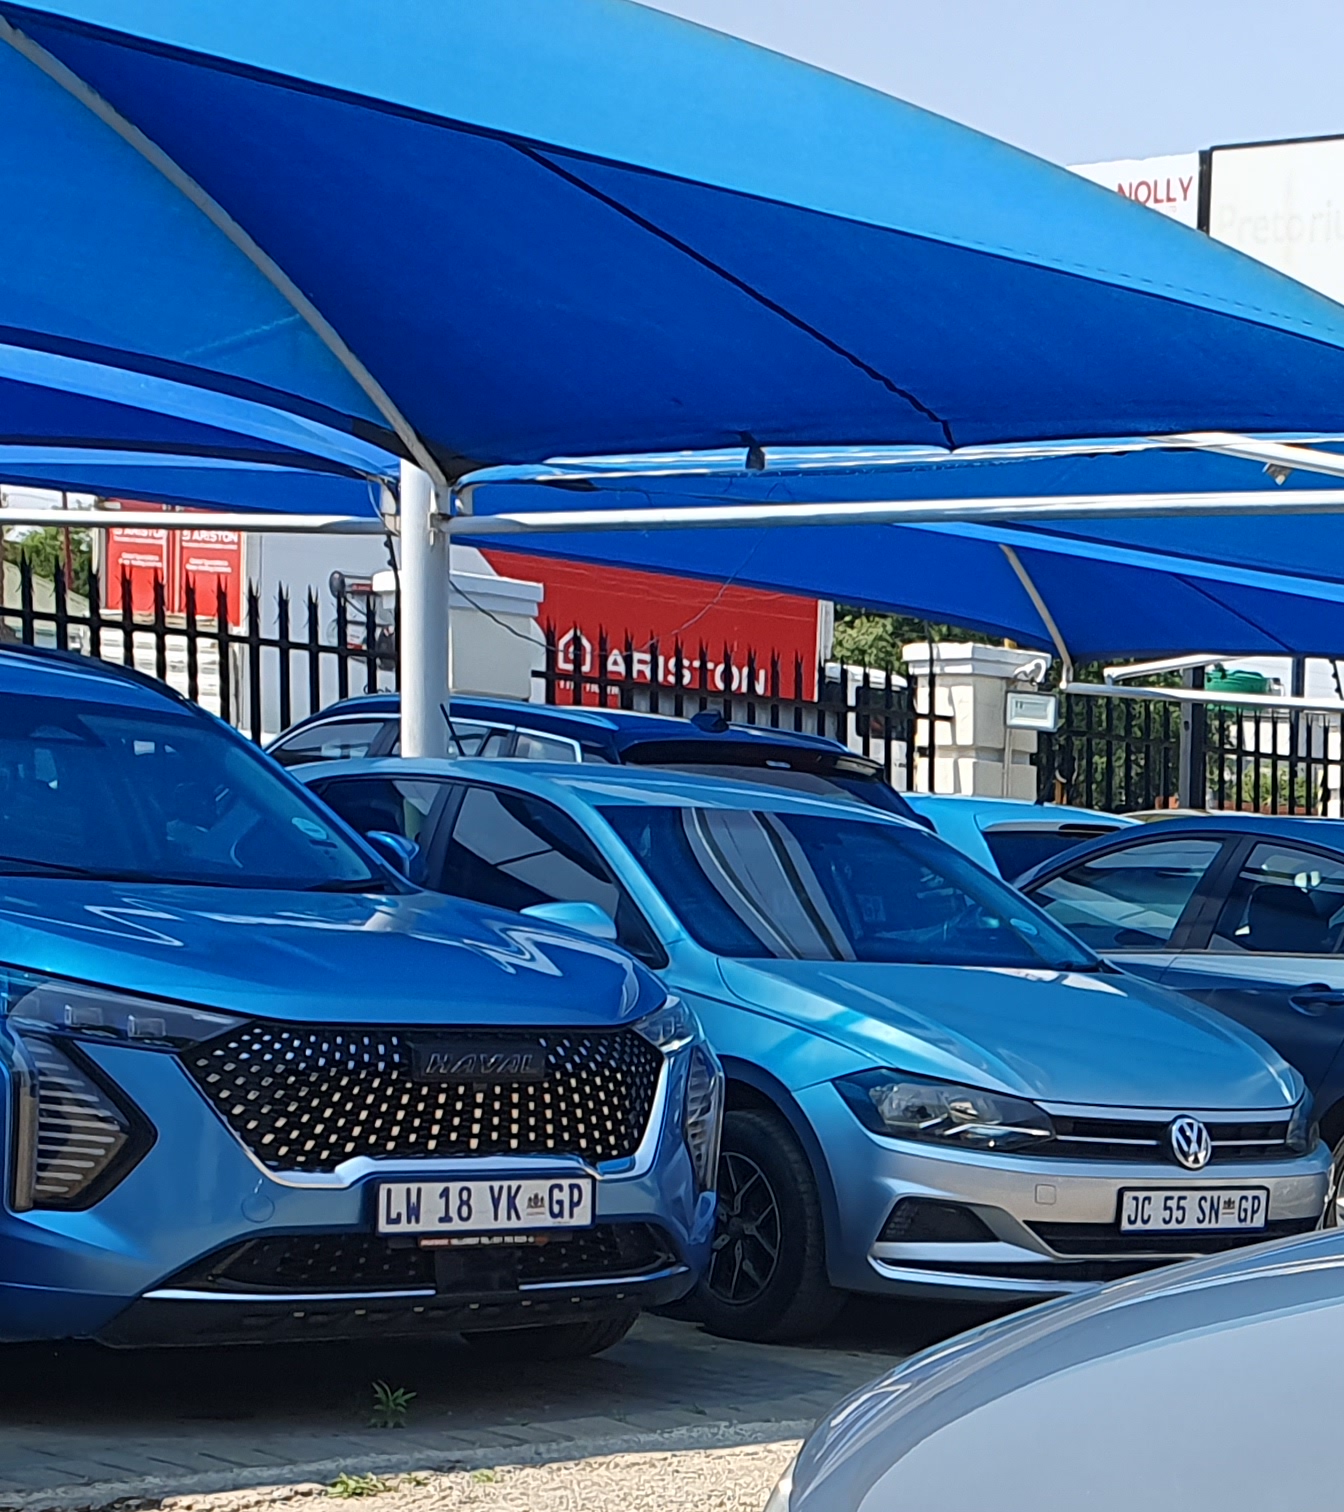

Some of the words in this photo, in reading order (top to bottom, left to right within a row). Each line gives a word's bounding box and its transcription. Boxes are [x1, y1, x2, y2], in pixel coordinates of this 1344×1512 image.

[1117, 176, 1193, 206] NOLLY
[424, 1052, 539, 1074] HAVAL
[385, 1186, 423, 1226] LW
[437, 1185, 473, 1224] 18
[488, 1184, 523, 1222] YK
[548, 1183, 584, 1220] GP
[1127, 1195, 1152, 1226] JC
[1162, 1195, 1188, 1225] 55
[1196, 1195, 1221, 1225] SN
[1237, 1195, 1261, 1224] GP
